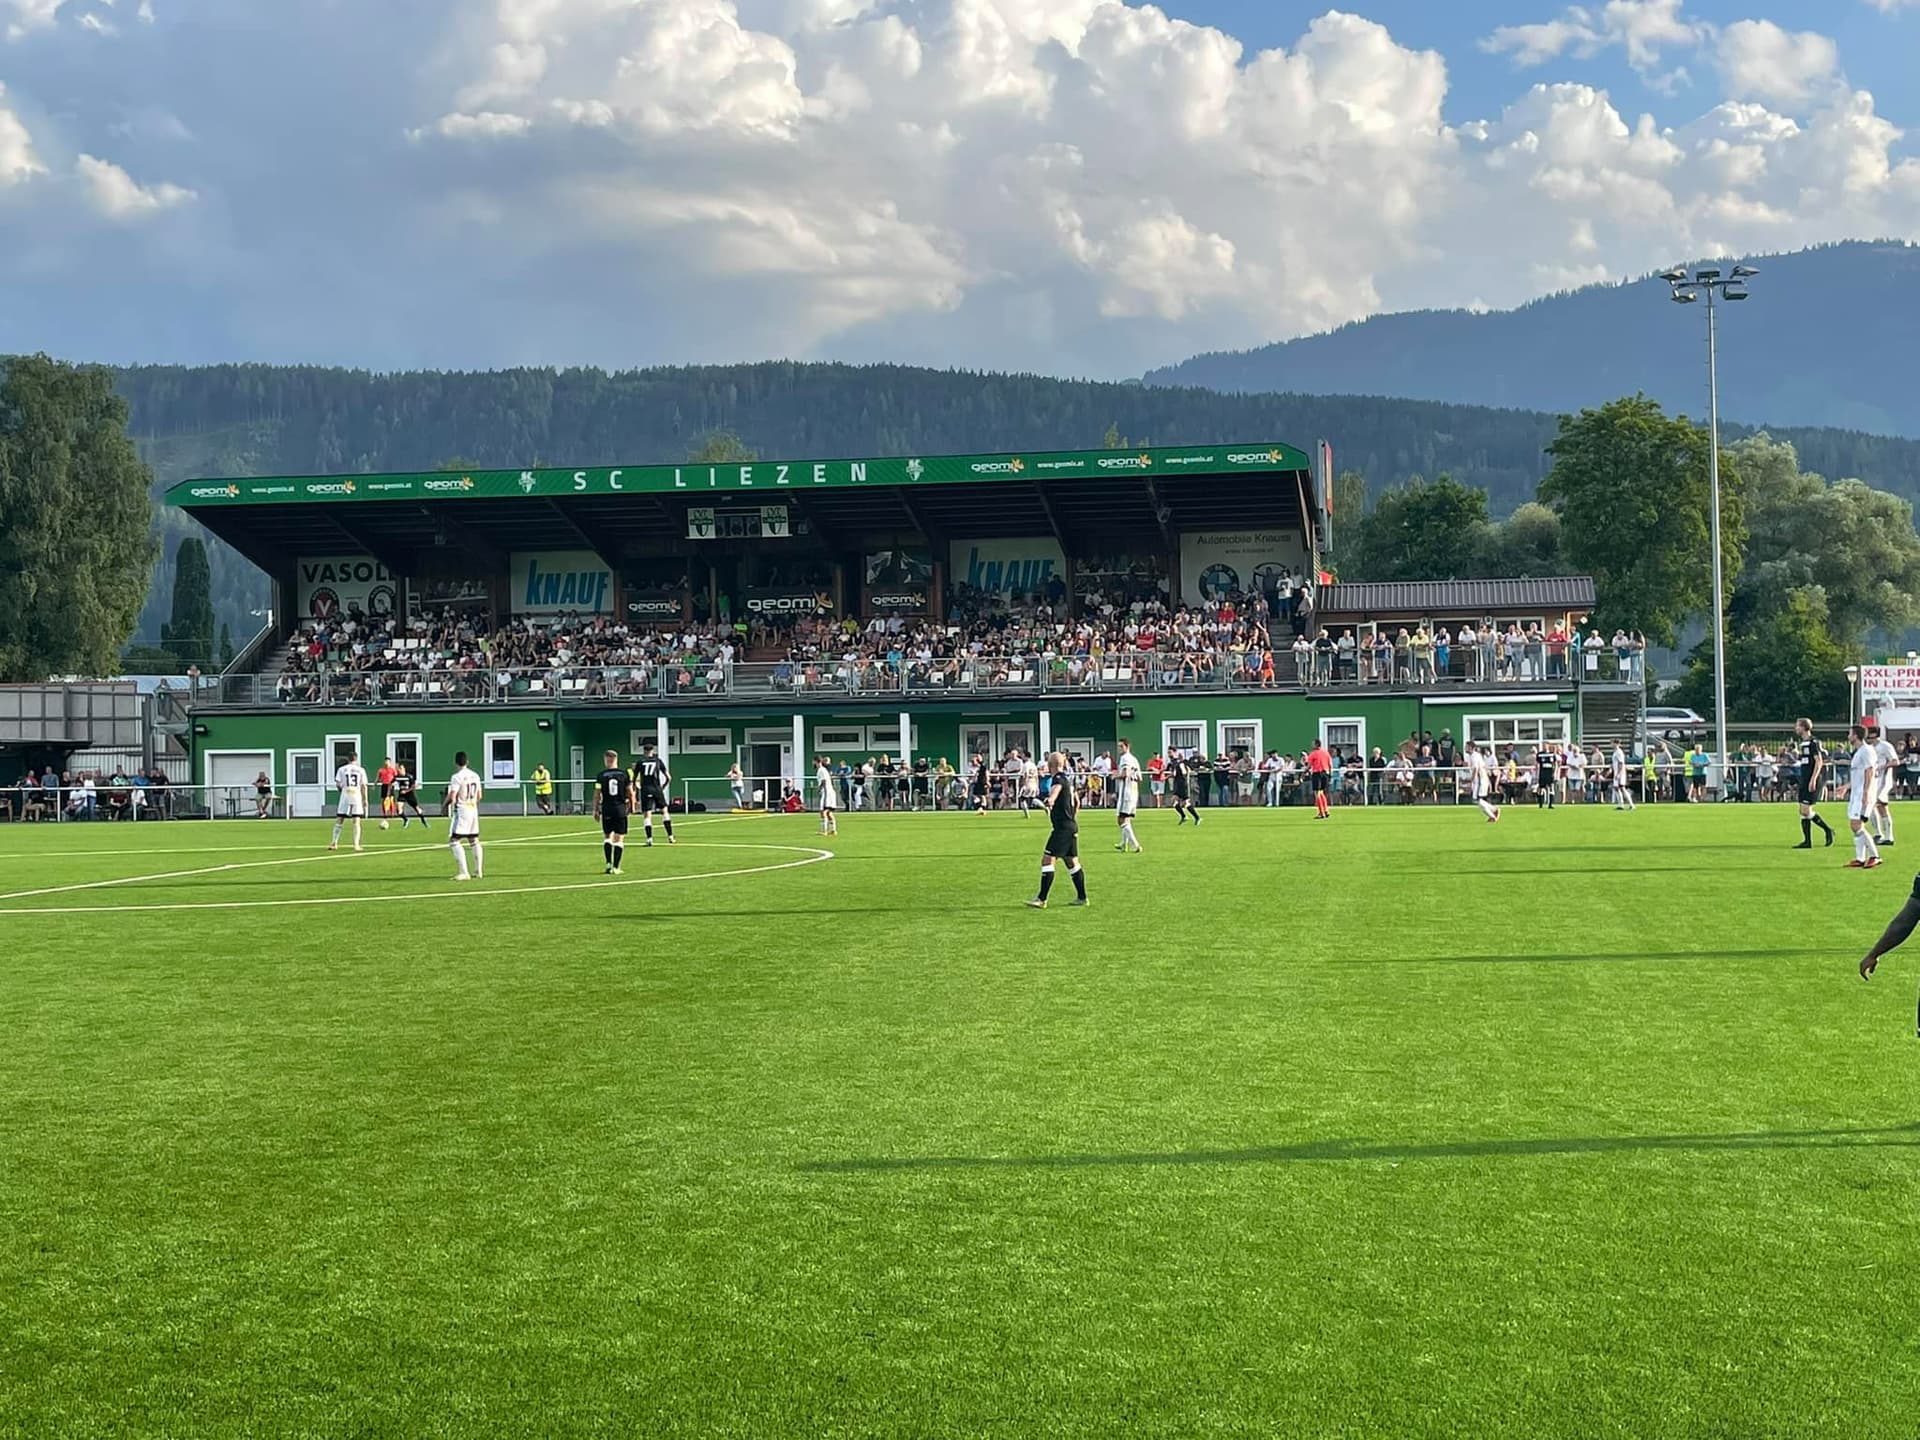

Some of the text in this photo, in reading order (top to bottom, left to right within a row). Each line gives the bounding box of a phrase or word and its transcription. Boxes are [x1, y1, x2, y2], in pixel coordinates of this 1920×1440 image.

[574, 463, 867, 490] SC LIEZEN
[302, 562, 395, 583] VASOL
[525, 559, 609, 612] KNAUF
[1864, 680, 1878, 688] IN
[642, 762, 656, 776] 77
[345, 774, 358, 787] 13
[608, 778, 618, 796] 6
